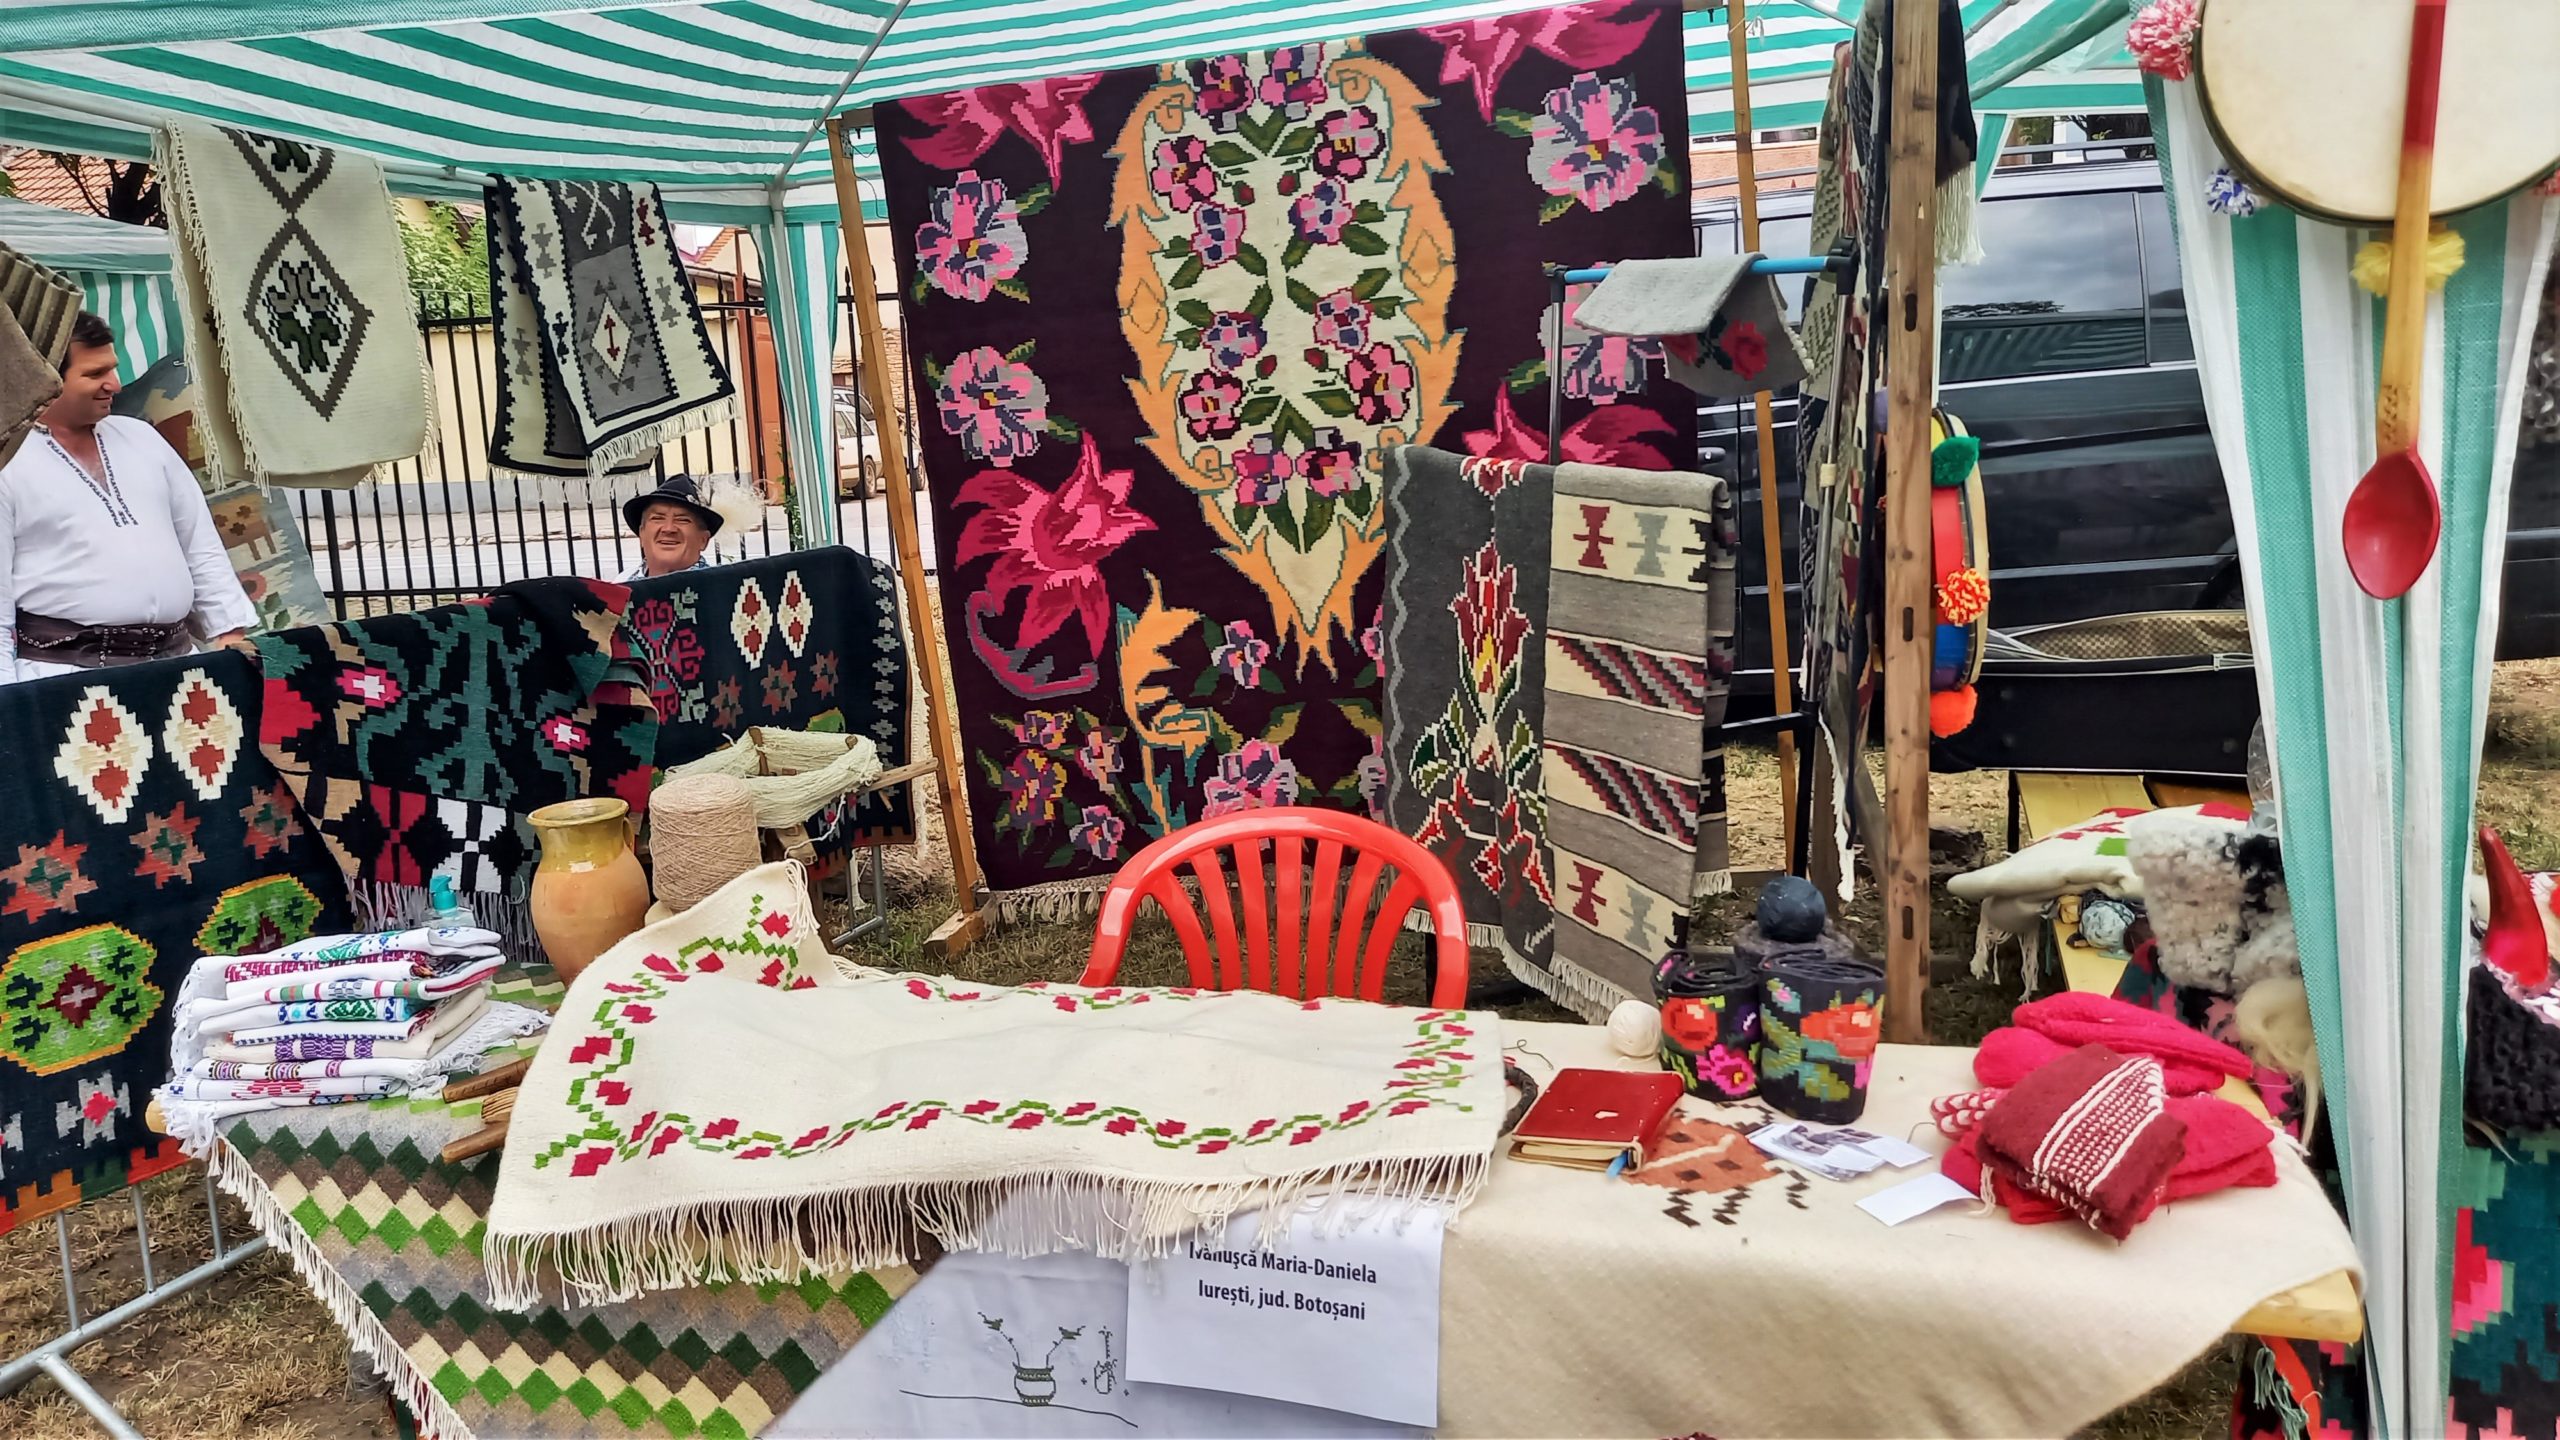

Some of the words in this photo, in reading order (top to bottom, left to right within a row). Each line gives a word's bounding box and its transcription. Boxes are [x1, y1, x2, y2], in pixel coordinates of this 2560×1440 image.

[1261, 1252, 1377, 1284] Maria-Daniela
[1198, 1279, 1255, 1306] Iurești,
[1257, 1287, 1290, 1309] jud.
[1294, 1292, 1366, 1321] Botoșani
